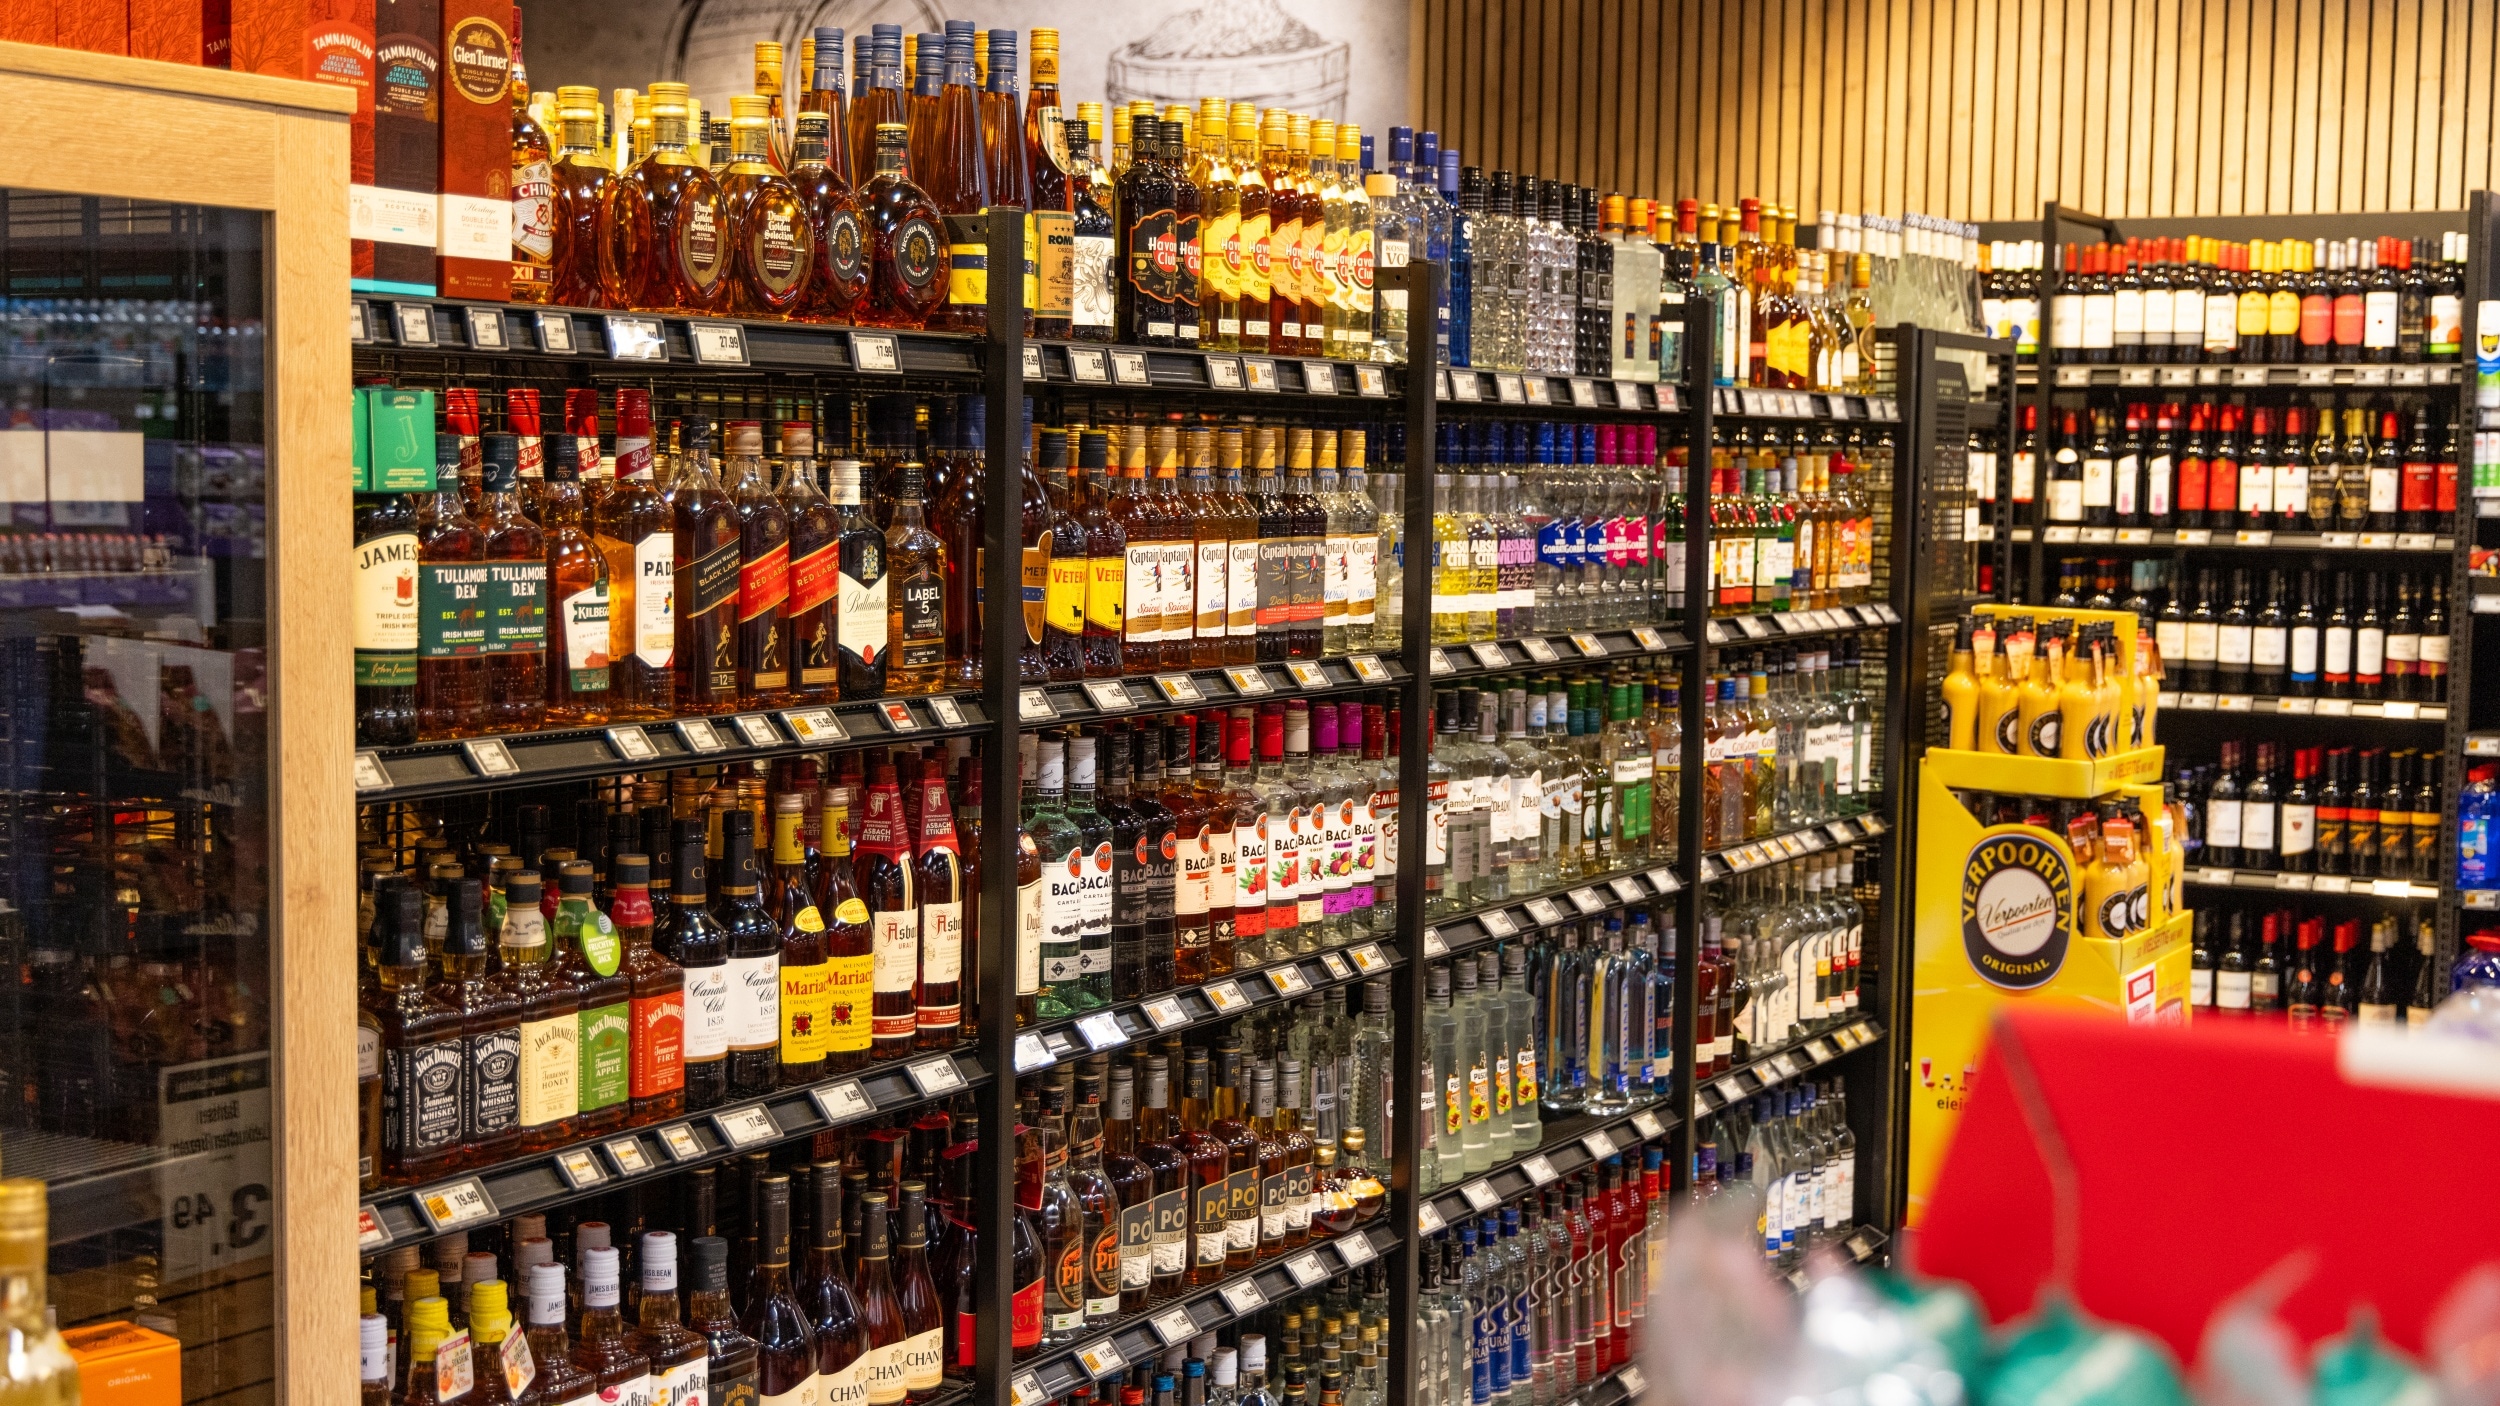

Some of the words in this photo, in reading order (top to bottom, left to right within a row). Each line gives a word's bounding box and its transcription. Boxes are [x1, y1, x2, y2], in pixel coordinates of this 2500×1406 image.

[313, 32, 374, 60] TAMNAVULIN
[327, 54, 357, 64] SPEYSIDE
[378, 44, 438, 72] TAMNAVULIN
[320, 65, 342, 73] SCOTCH
[393, 66, 422, 76] SPEYSIDE
[463, 68, 484, 77] SINGLE
[315, 73, 335, 81] SHERRY
[336, 75, 349, 83] CASK
[350, 77, 369, 86] EDITION
[385, 76, 407, 85] SCOTCH
[409, 79, 429, 88] WHISKY
[389, 71, 411, 80] SINGLE
[413, 74, 426, 82] MALT
[461, 74, 481, 82] SCOTCH
[390, 86, 410, 94] DOUBLE
[412, 88, 425, 96] CASK
[768, 222, 791, 232] Golden
[764, 230, 794, 241] Selection
[512, 266, 534, 281] XII
[719, 335, 740, 349] 27.99
[875, 345, 894, 358] 17.99
[703, 560, 723, 575] JOHNNIE
[722, 549, 740, 563] WALKER
[435, 569, 487, 584] TULLAMORE
[492, 566, 547, 581] TULLAMORE
[699, 569, 722, 587] BLACK
[797, 573, 815, 587] RED
[512, 582, 537, 597] D.E.W.
[750, 576, 767, 591] RED
[455, 585, 478, 599] D.E.W.
[908, 587, 940, 602] LABEL
[498, 608, 513, 616] EST.
[921, 600, 930, 614] 5
[463, 629, 485, 637] WHISKEY
[499, 627, 518, 635] IRISH
[520, 626, 544, 634] WHISKEY
[718, 674, 728, 686] 12
[813, 717, 834, 728] 15.99
[926, 821, 951, 829] ASBACH
[926, 828, 952, 836] ETIKETT!
[1962, 841, 2070, 932] VERPOORTEN
[1977, 894, 2052, 928] Verpoorten
[587, 938, 616, 951] FRUCHTIG
[597, 954, 612, 964] JACK
[1982, 954, 2050, 975] ORIGINAL
[647, 1008, 663, 1027] JACK
[663, 1002, 684, 1020] DANIEL'S
[588, 1022, 604, 1041] JACK
[604, 1014, 628, 1033] DANIEL'S
[534, 1035, 551, 1052] JACK
[552, 1025, 578, 1044] DANIEL'S
[475, 1041, 494, 1064] JACK
[494, 1036, 520, 1057] DANIEL'S
[654, 1045, 679, 1056] Tennessee
[415, 1053, 434, 1077] JACK
[434, 1048, 462, 1069] DANIEL'S
[595, 1056, 621, 1069] Tennessee
[657, 1052, 676, 1064] FIRE
[542, 1069, 570, 1081] Tennessee
[596, 1064, 621, 1077] APPLE
[934, 1065, 953, 1078] 13.99
[483, 1082, 513, 1095] Tennessee
[542, 1077, 570, 1090] HONEY
[424, 1095, 455, 1108] Tennessee
[481, 1093, 515, 1108] WHISKEY
[847, 1089, 862, 1102] 8.99
[422, 1106, 456, 1121] WHISKEY
[746, 1115, 768, 1129] 17.99
[454, 1190, 481, 1208] 19.99
[1227, 1210, 1247, 1219] RUM
[1198, 1224, 1221, 1233] RUM
[1154, 1233, 1176, 1242] RUM
[1122, 1247, 1144, 1256] RUM
[589, 1283, 606, 1295] JAMES
[1172, 1316, 1189, 1328] 11.99
[107, 1373, 152, 1387] ORIGINAL
[671, 1379, 690, 1405] JIM
